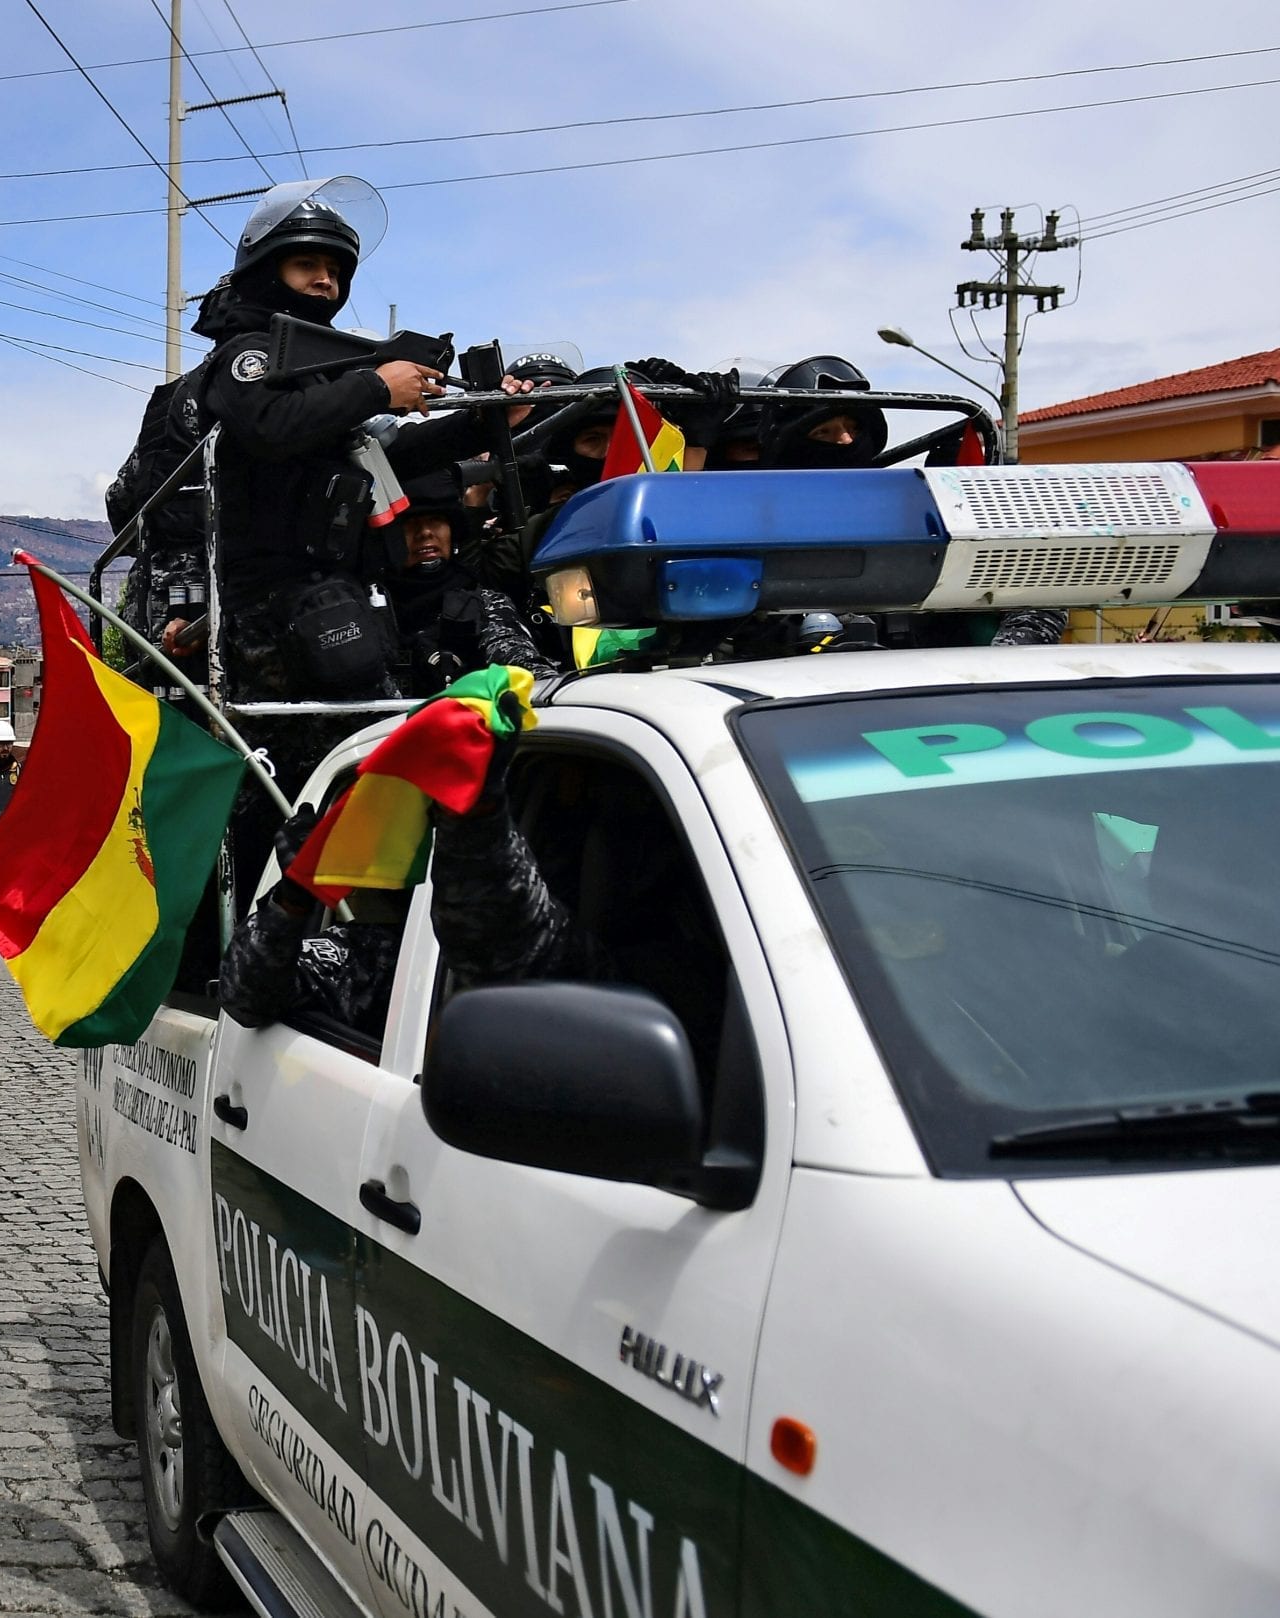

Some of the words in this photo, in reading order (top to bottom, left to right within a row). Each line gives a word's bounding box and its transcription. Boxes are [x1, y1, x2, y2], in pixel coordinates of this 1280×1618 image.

[320, 627, 361, 646] SNIPER
[215, 1191, 348, 1414] POLICIA
[620, 1325, 724, 1419] HILUX
[248, 1384, 357, 1546] SEGURIDAD
